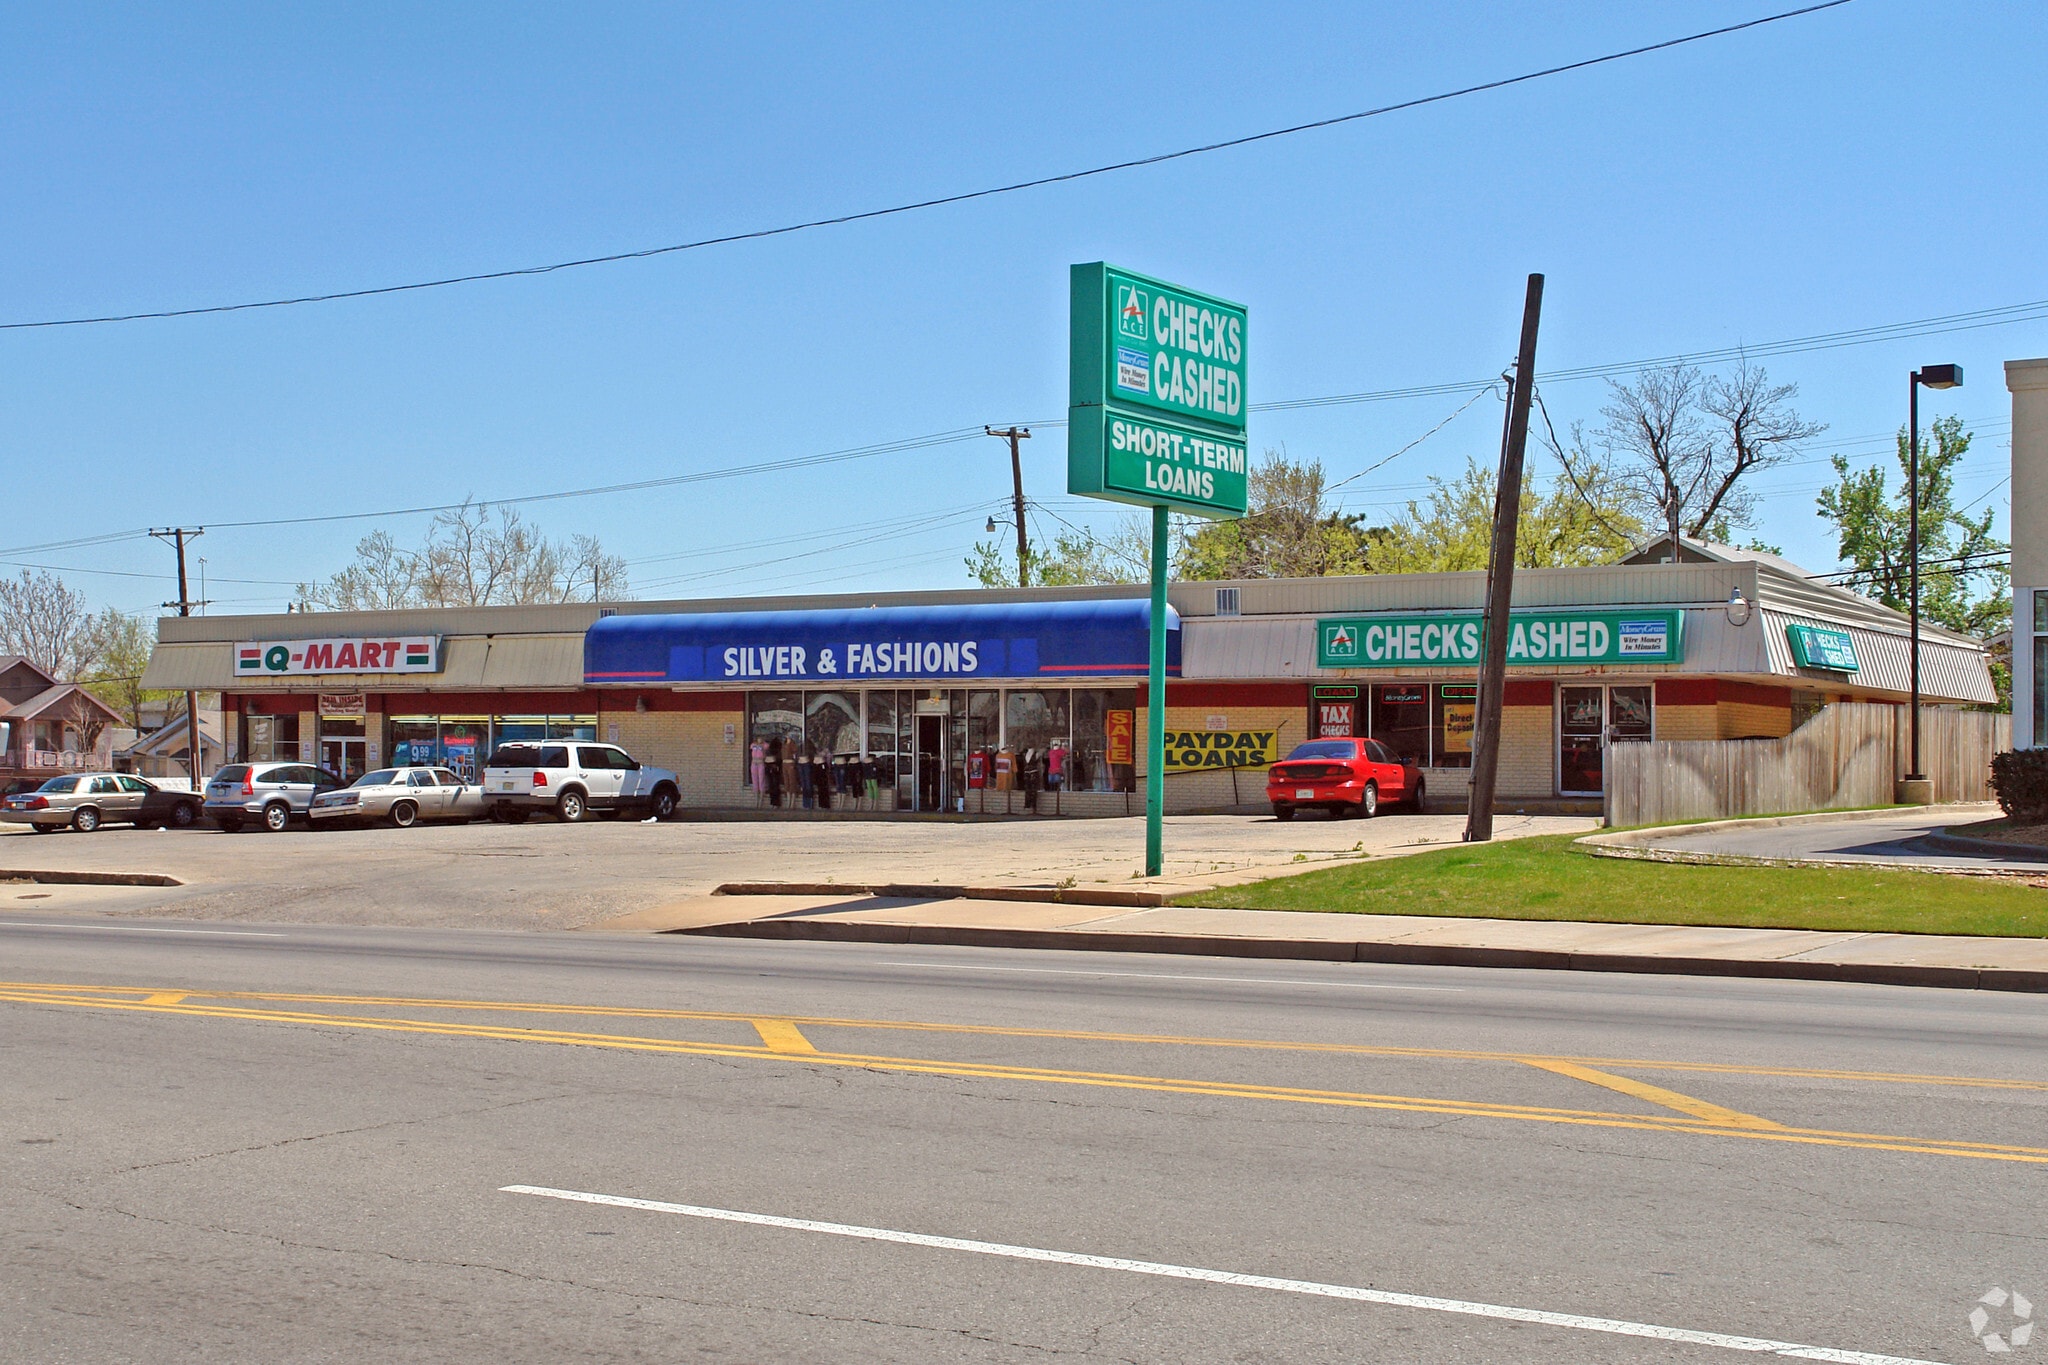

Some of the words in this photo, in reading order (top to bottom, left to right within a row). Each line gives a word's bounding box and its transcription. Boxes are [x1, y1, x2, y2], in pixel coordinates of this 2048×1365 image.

[1122, 320, 1144, 335] ACE
[1153, 295, 1241, 365] CHECKS
[1154, 351, 1241, 416] CASHED
[1112, 420, 1244, 474] SHORT-TERM
[1145, 460, 1214, 499] LOANS
[1365, 623, 1478, 660] CHECKS
[1506, 621, 1610, 660] ASHED
[1640, 636, 1662, 644] Money
[264, 642, 401, 672] Q-MART
[724, 646, 806, 676] SILVER
[817, 648, 837, 673] &
[847, 641, 978, 673] FASHIONS
[1320, 705, 1350, 723] TAX
[1450, 713, 1472, 722] Direct
[1111, 712, 1130, 760] SALE
[1164, 733, 1274, 749] PAYDAY
[1320, 725, 1350, 736] CHECKS
[1165, 750, 1266, 767] LOANS
